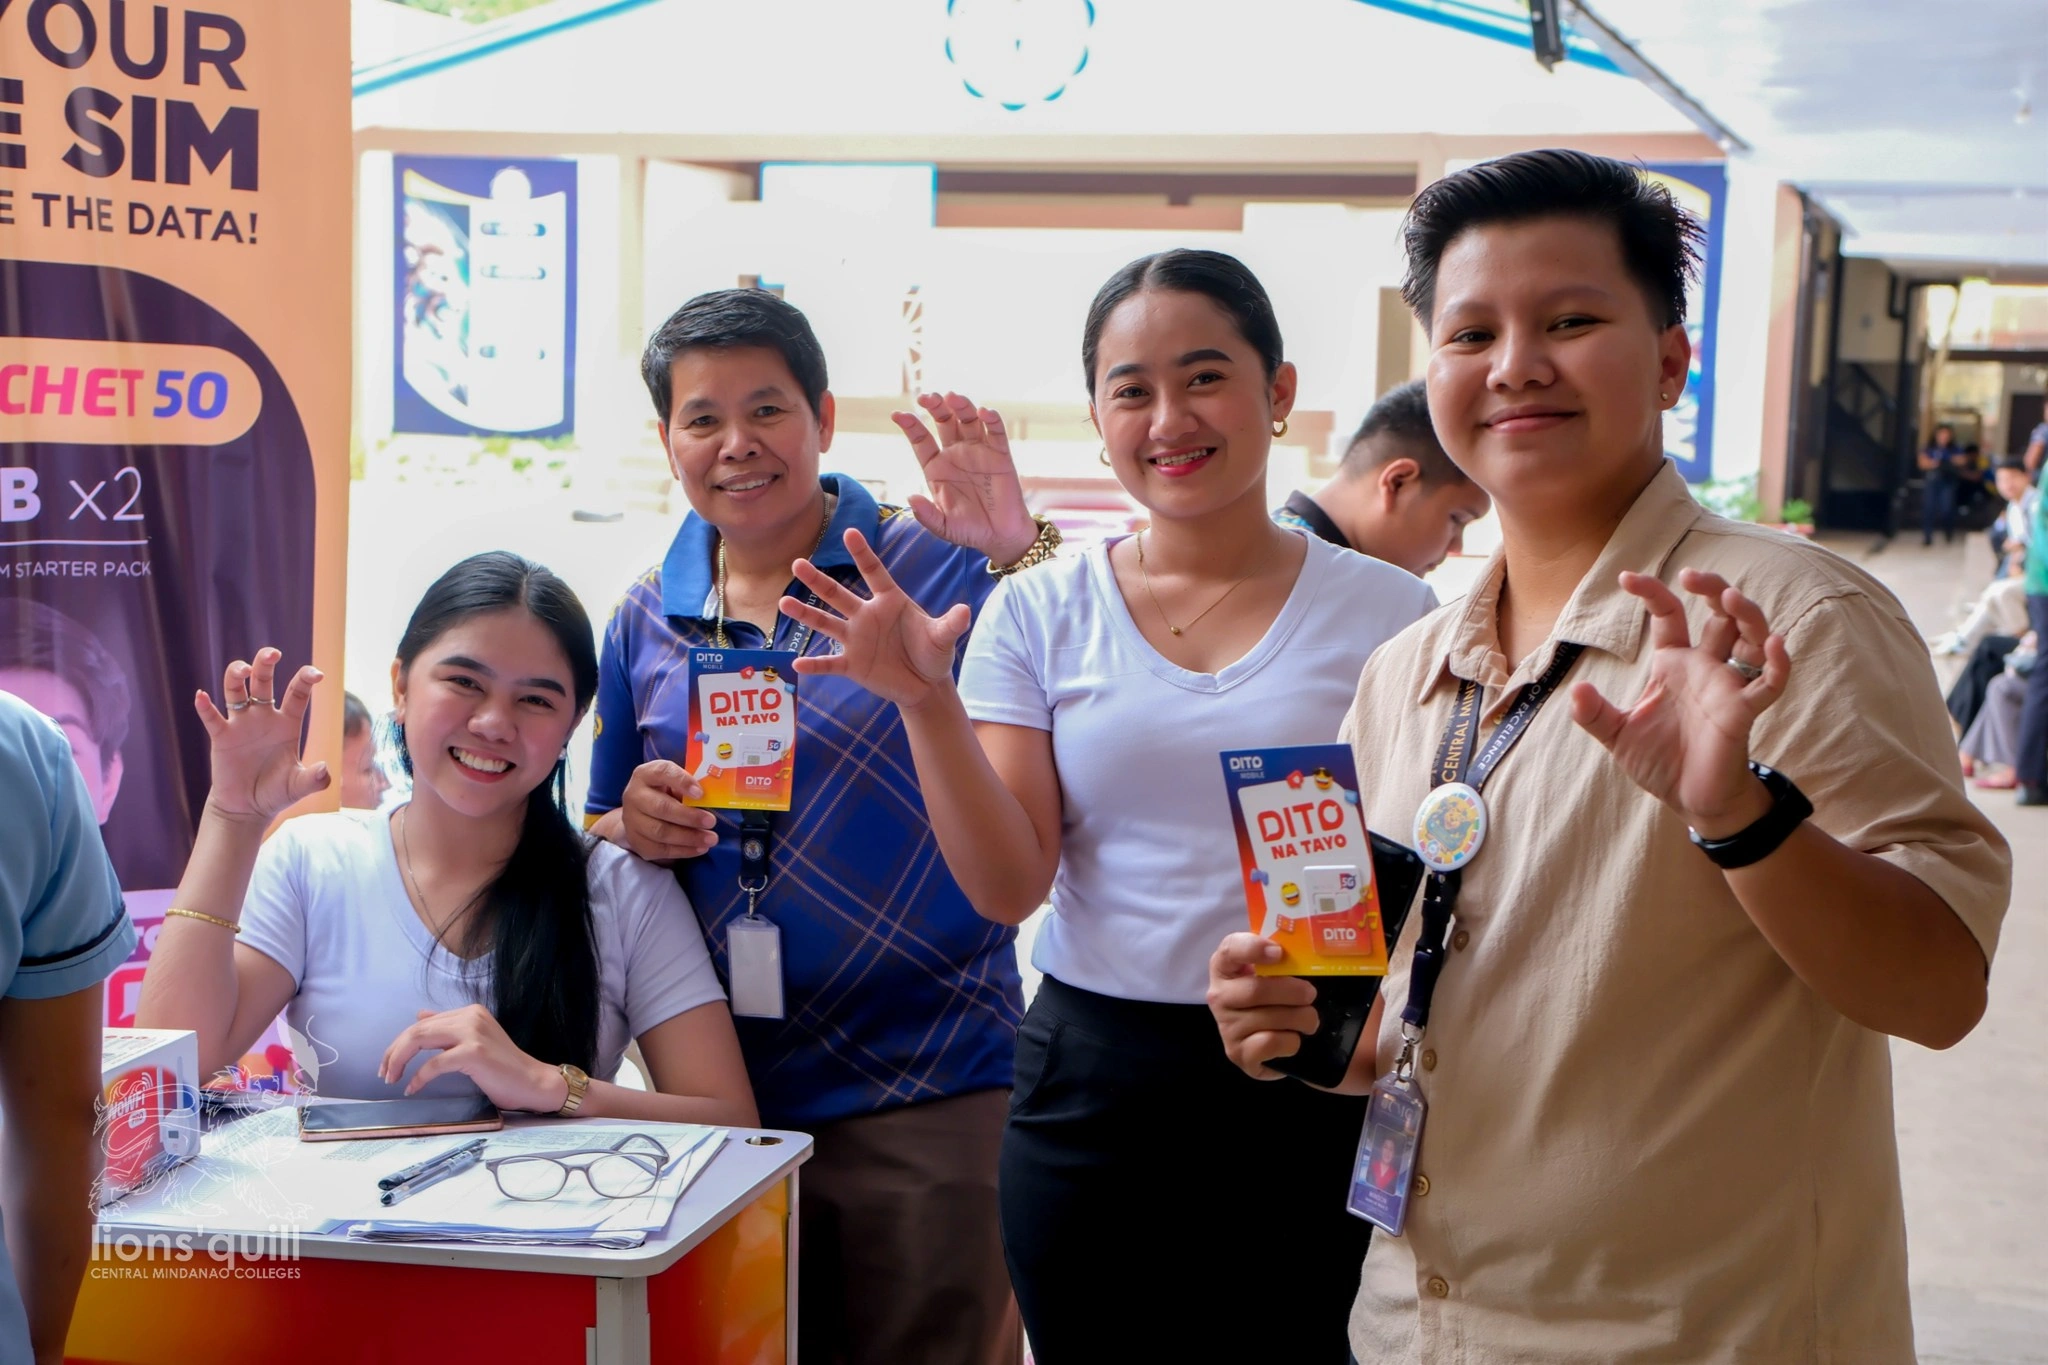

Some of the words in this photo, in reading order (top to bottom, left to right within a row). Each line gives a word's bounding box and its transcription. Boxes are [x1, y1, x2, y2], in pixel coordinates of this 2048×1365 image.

[0, 0, 247, 91] OUR
[62, 86, 259, 192] SIM
[32, 192, 114, 232] THE
[129, 202, 258, 245] DATA!
[152, 370, 229, 420] 50
[15, 560, 98, 578] STARTER
[103, 560, 151, 577] PACK
[696, 652, 723, 663] DITO
[709, 688, 782, 714] DITO
[1527, 683, 1542, 702] OF
[716, 716, 738, 727] NA
[741, 712, 780, 726] TAYO
[1477, 702, 1531, 771] EXCELLENCE
[1229, 756, 1263, 770] DITO
[1442, 719, 1470, 783] CENTRAL
[745, 775, 772, 787] DITO
[1256, 798, 1345, 843] DITO
[1271, 843, 1298, 860] NA
[1300, 833, 1347, 855] TAYO
[1323, 927, 1357, 941] DITO
